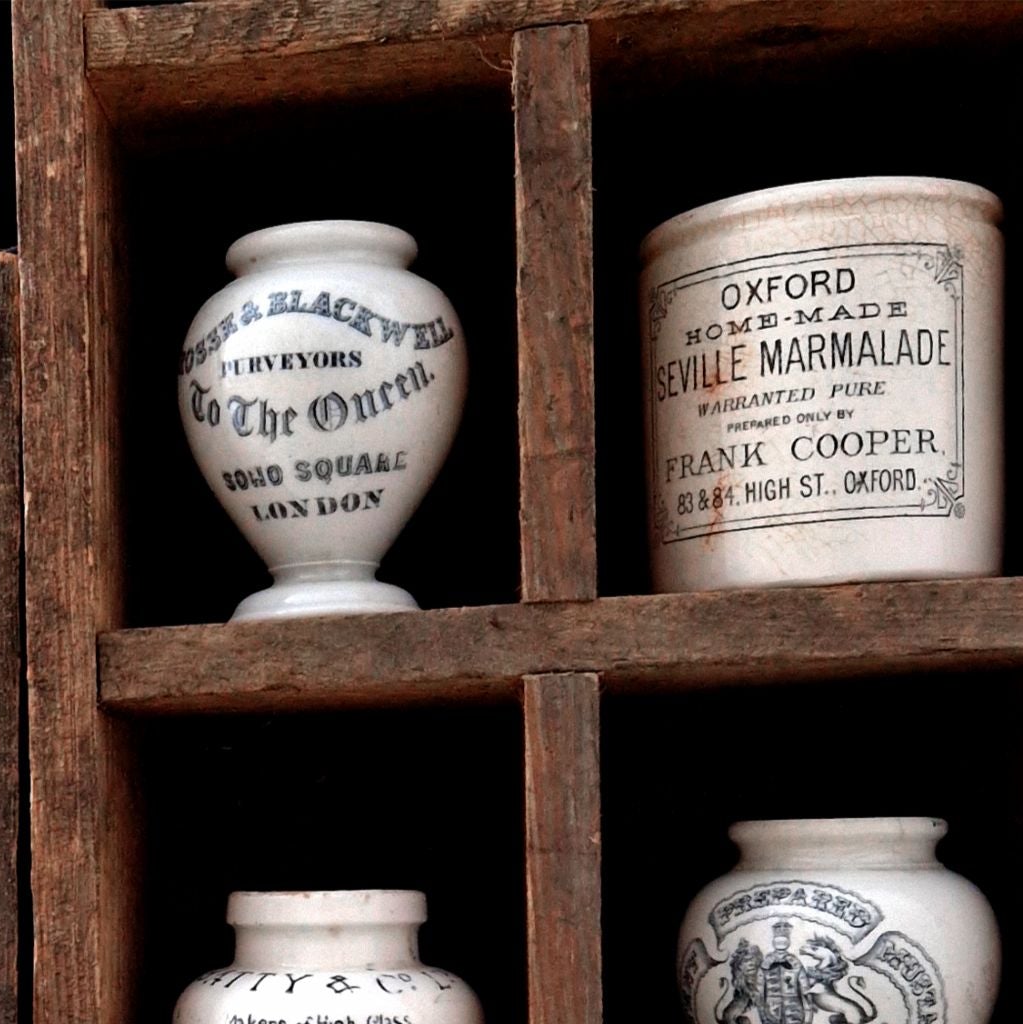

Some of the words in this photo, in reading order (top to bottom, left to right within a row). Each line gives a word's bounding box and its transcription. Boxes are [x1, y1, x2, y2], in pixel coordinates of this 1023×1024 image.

[721, 267, 856, 311] OXFORD
[239, 300, 263, 327] &
[685, 301, 908, 346] HOME-MADE
[220, 351, 363, 378] PURVEYORS
[657, 343, 747, 402] SEVILLE
[760, 329, 951, 378] MARMALADE
[189, 379, 220, 427] To
[227, 395, 298, 444] The
[697, 386, 815, 418] WARRANTED
[830, 381, 887, 399] PURE
[727, 415, 791, 433] PREPARED
[796, 411, 832, 424] ONLY
[837, 409, 854, 420] BY
[222, 465, 283, 492] SOHO
[295, 451, 408, 485] SQUARE
[665, 441, 767, 484] FRANK
[251, 488, 385, 522] LONDON
[745, 477, 790, 505] HIGH
